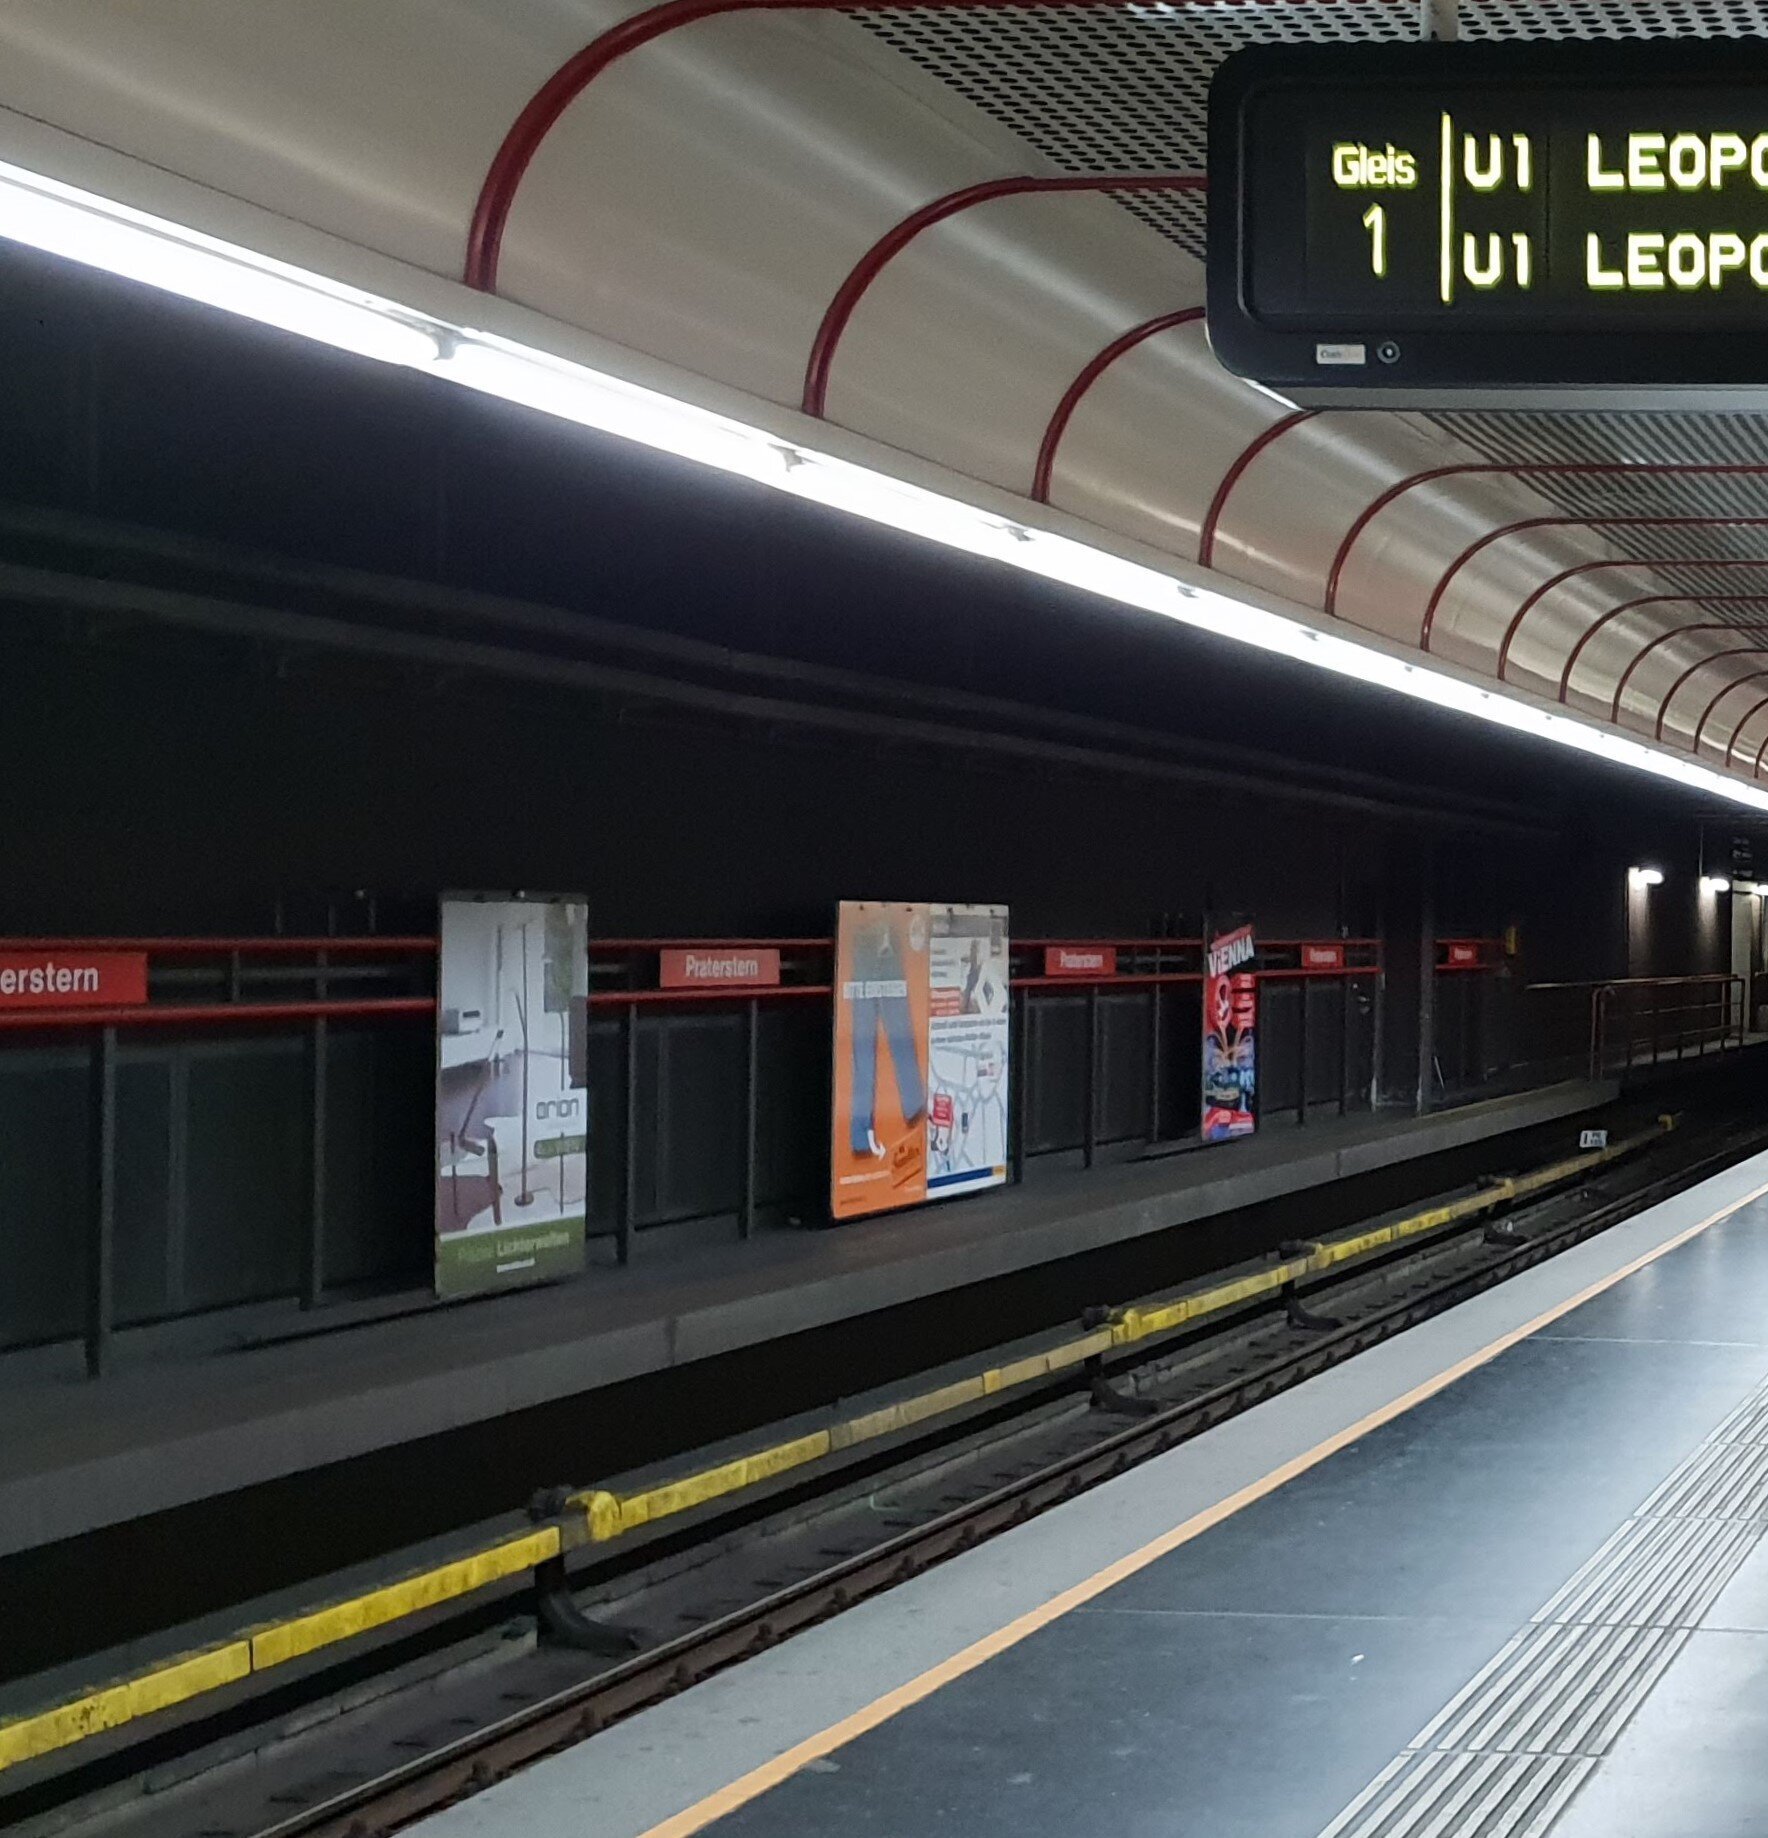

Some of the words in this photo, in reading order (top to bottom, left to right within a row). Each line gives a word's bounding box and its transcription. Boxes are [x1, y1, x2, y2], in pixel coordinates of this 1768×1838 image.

[1333, 142, 1418, 189] Gleis
[1463, 133, 1532, 191] U1
[1362, 202, 1387, 279] 1
[1463, 232, 1532, 290] U1
[685, 954, 758, 978] Praterstern
